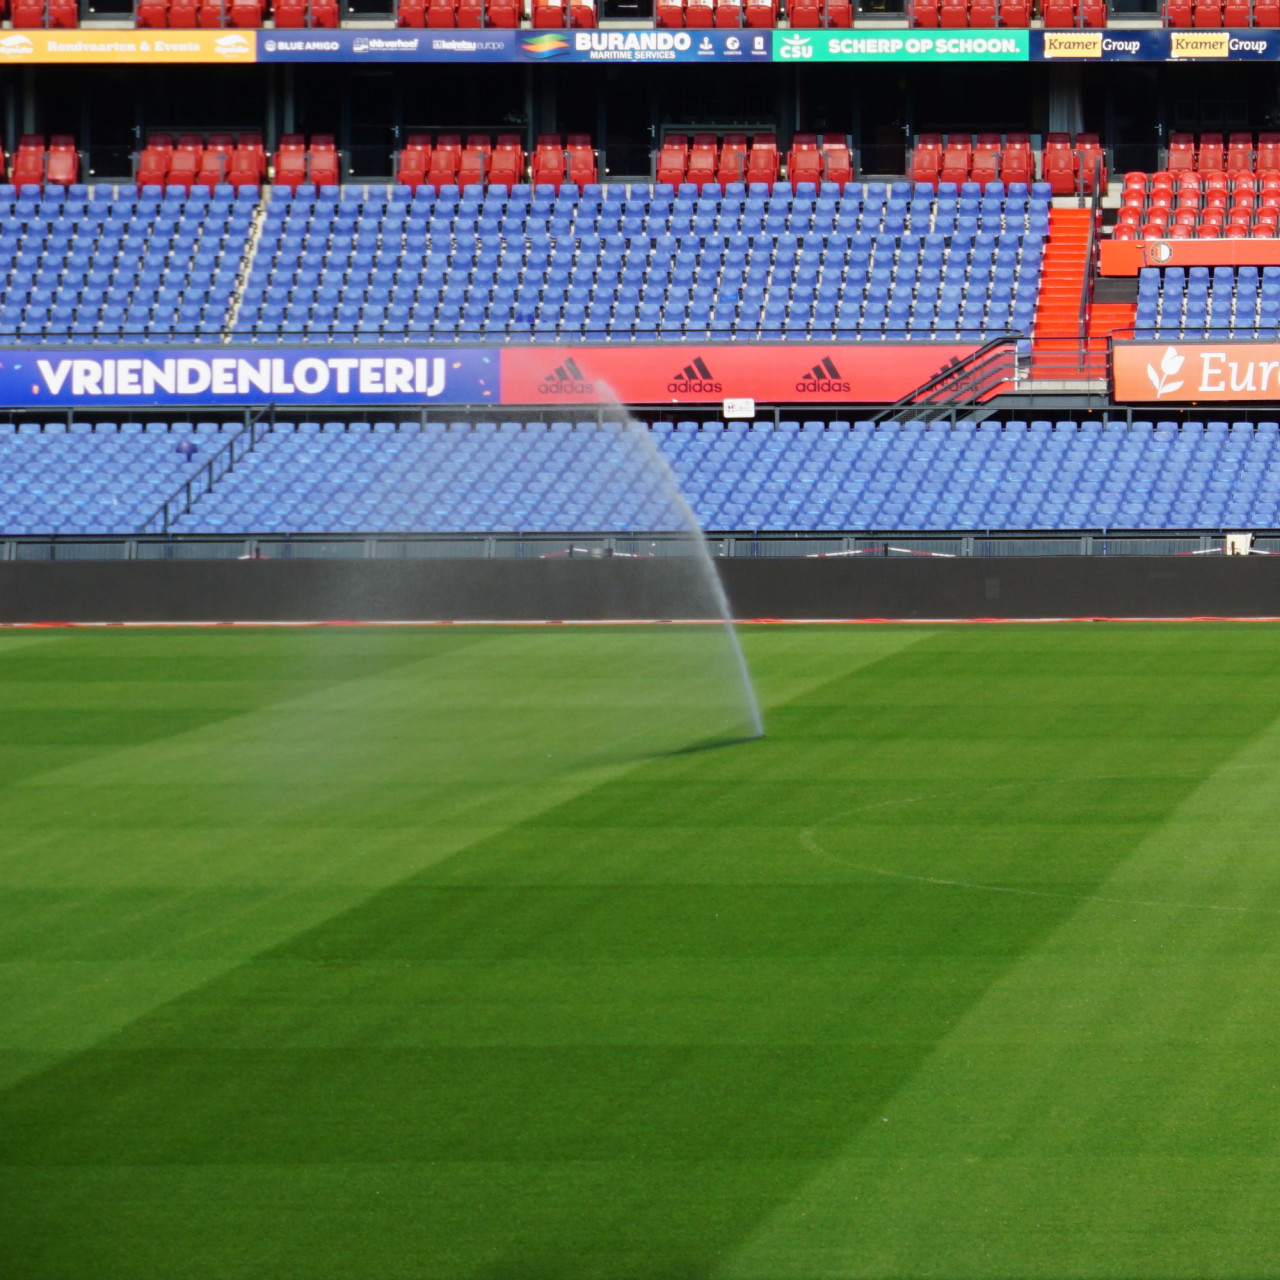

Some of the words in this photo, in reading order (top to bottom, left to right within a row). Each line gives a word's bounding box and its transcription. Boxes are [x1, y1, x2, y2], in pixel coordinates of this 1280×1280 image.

[47, 40, 137, 52] Rondvaarten
[140, 40, 151, 52] &
[154, 40, 201, 52] Events
[277, 41, 303, 51] BLUE
[304, 41, 340, 51] AMIGO
[575, 32, 692, 51] BURANDO
[828, 38, 903, 54] SCHERP
[905, 38, 933, 53] OP
[935, 38, 1021, 53] SCHOON.
[1048, 38, 1099, 51] Kramer
[1102, 38, 1141, 54] Group
[1175, 38, 1226, 51] Kramer
[1229, 38, 1268, 54] Group
[590, 50, 633, 60] MARITIME
[634, 50, 676, 60] SERVICES
[780, 45, 813, 58] CSU
[37, 358, 446, 396] VRIENDENLOTERIJ
[537, 381, 594, 394] adidas
[667, 379, 722, 393] adidas
[796, 379, 851, 393] adidas
